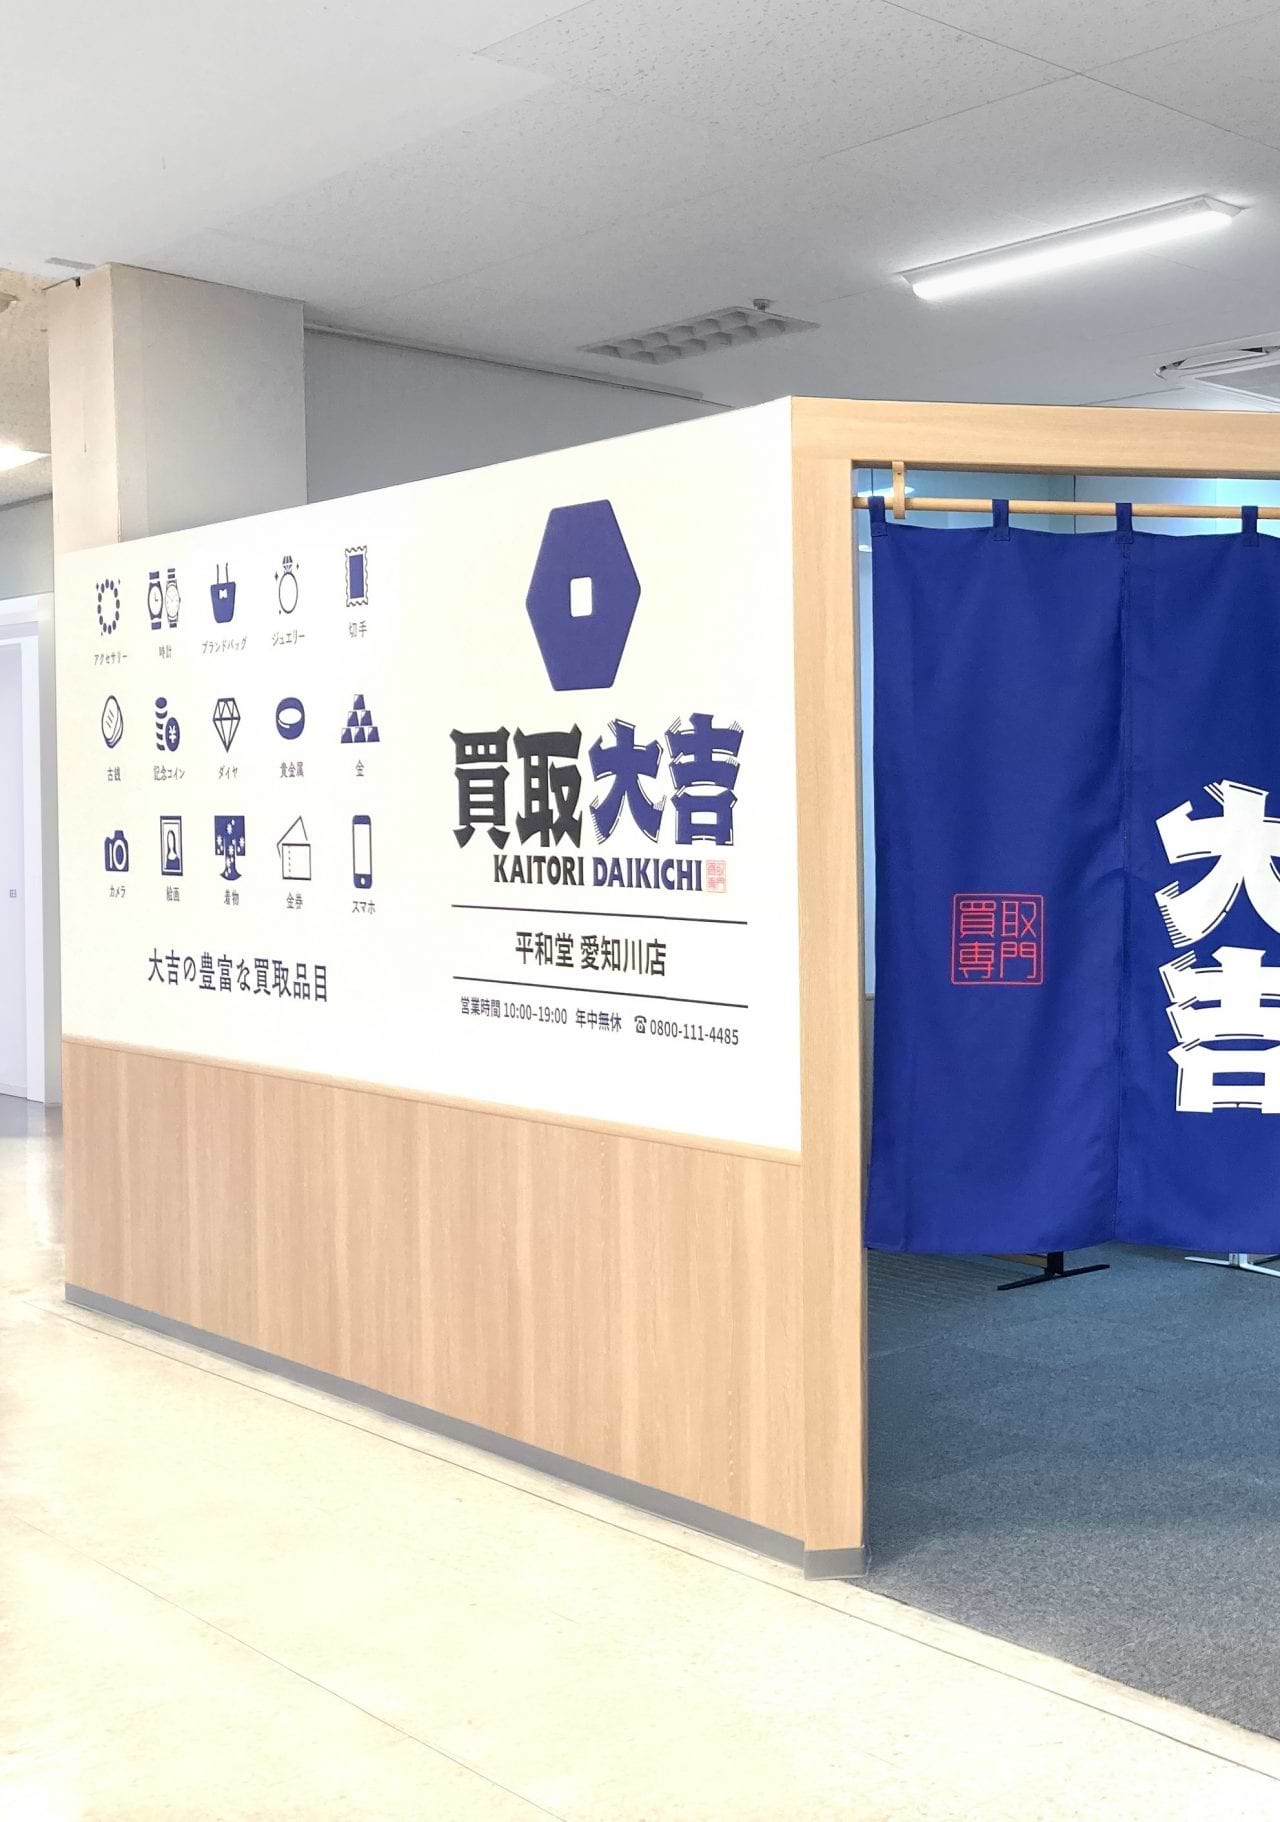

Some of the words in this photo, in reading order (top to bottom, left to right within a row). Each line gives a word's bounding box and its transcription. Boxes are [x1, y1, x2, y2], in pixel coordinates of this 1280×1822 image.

[271, 629, 306, 647] ジュエリー
[348, 619, 368, 639] 切手
[201, 635, 248, 655] ブランドバッグ
[153, 764, 186, 782] 記念コイン
[218, 765, 239, 780] ダイヤ
[279, 761, 305, 779] 貴金属
[354, 758, 367, 778] 金
[450, 712, 744, 850] 買取大吉
[494, 855, 584, 886] KAITORI
[592, 857, 702, 891] DAIKICHI
[108, 884, 127, 899] カメラ
[351, 900, 376, 915] スマホ
[516, 932, 574, 968] 平和堂
[581, 935, 666, 976] 愛知川店
[148, 948, 327, 1002] 大吉の豊富な買取品目
[461, 997, 500, 1018] 営業時間
[576, 1009, 621, 1032] 年中無休
[650, 1019, 740, 1046] 0800-111-4485
